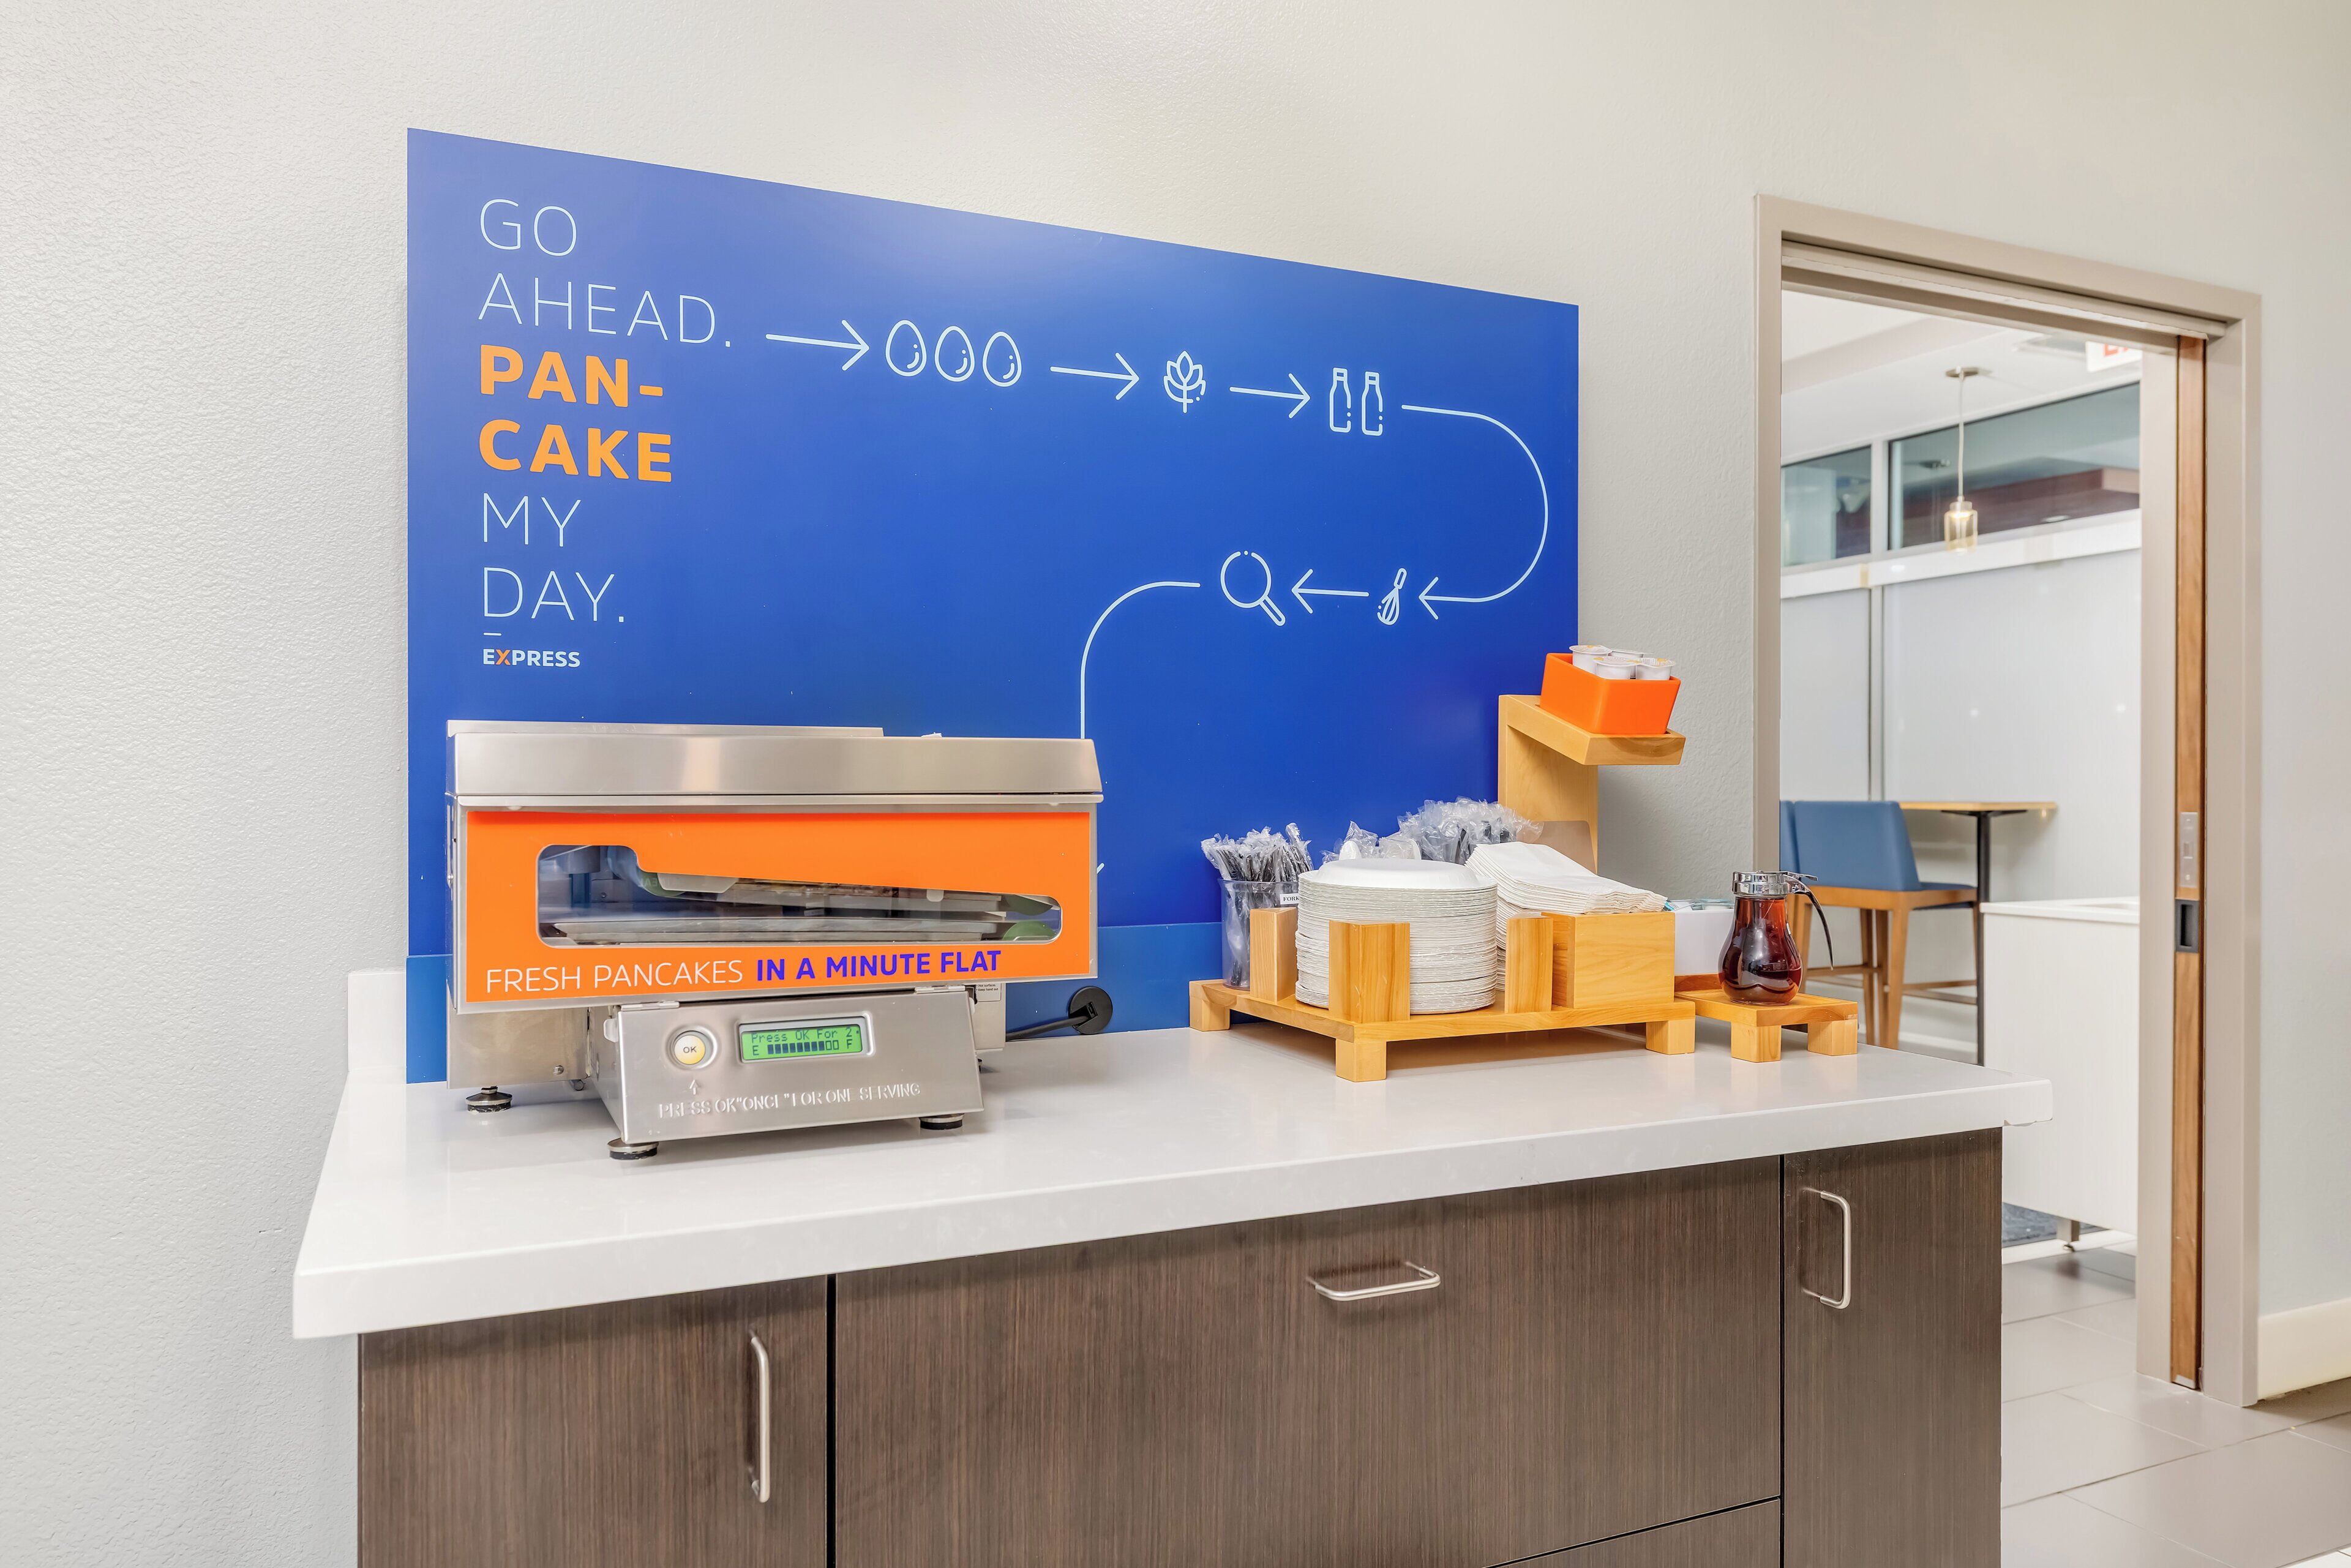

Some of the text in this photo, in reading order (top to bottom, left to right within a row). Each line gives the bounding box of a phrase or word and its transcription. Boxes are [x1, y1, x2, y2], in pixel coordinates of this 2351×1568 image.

[480, 198, 577, 257] GO
[478, 272, 731, 348] AHEAD.
[481, 345, 663, 407] PAN-
[479, 419, 672, 482] CAKE
[483, 492, 582, 547] MY
[484, 567, 624, 623] DAY.
[482, 648, 581, 668] EXPRESS
[487, 950, 1001, 993] FRESH PANCAKES IN A MINUTE FLAT
[751, 1032, 787, 1043] Press
[795, 1030, 810, 1040] OK
[817, 1029, 838, 1039] For
[752, 1039, 853, 1056] E F
[714, 1097, 737, 1112] OK
[860, 1082, 921, 1100] SERVING
